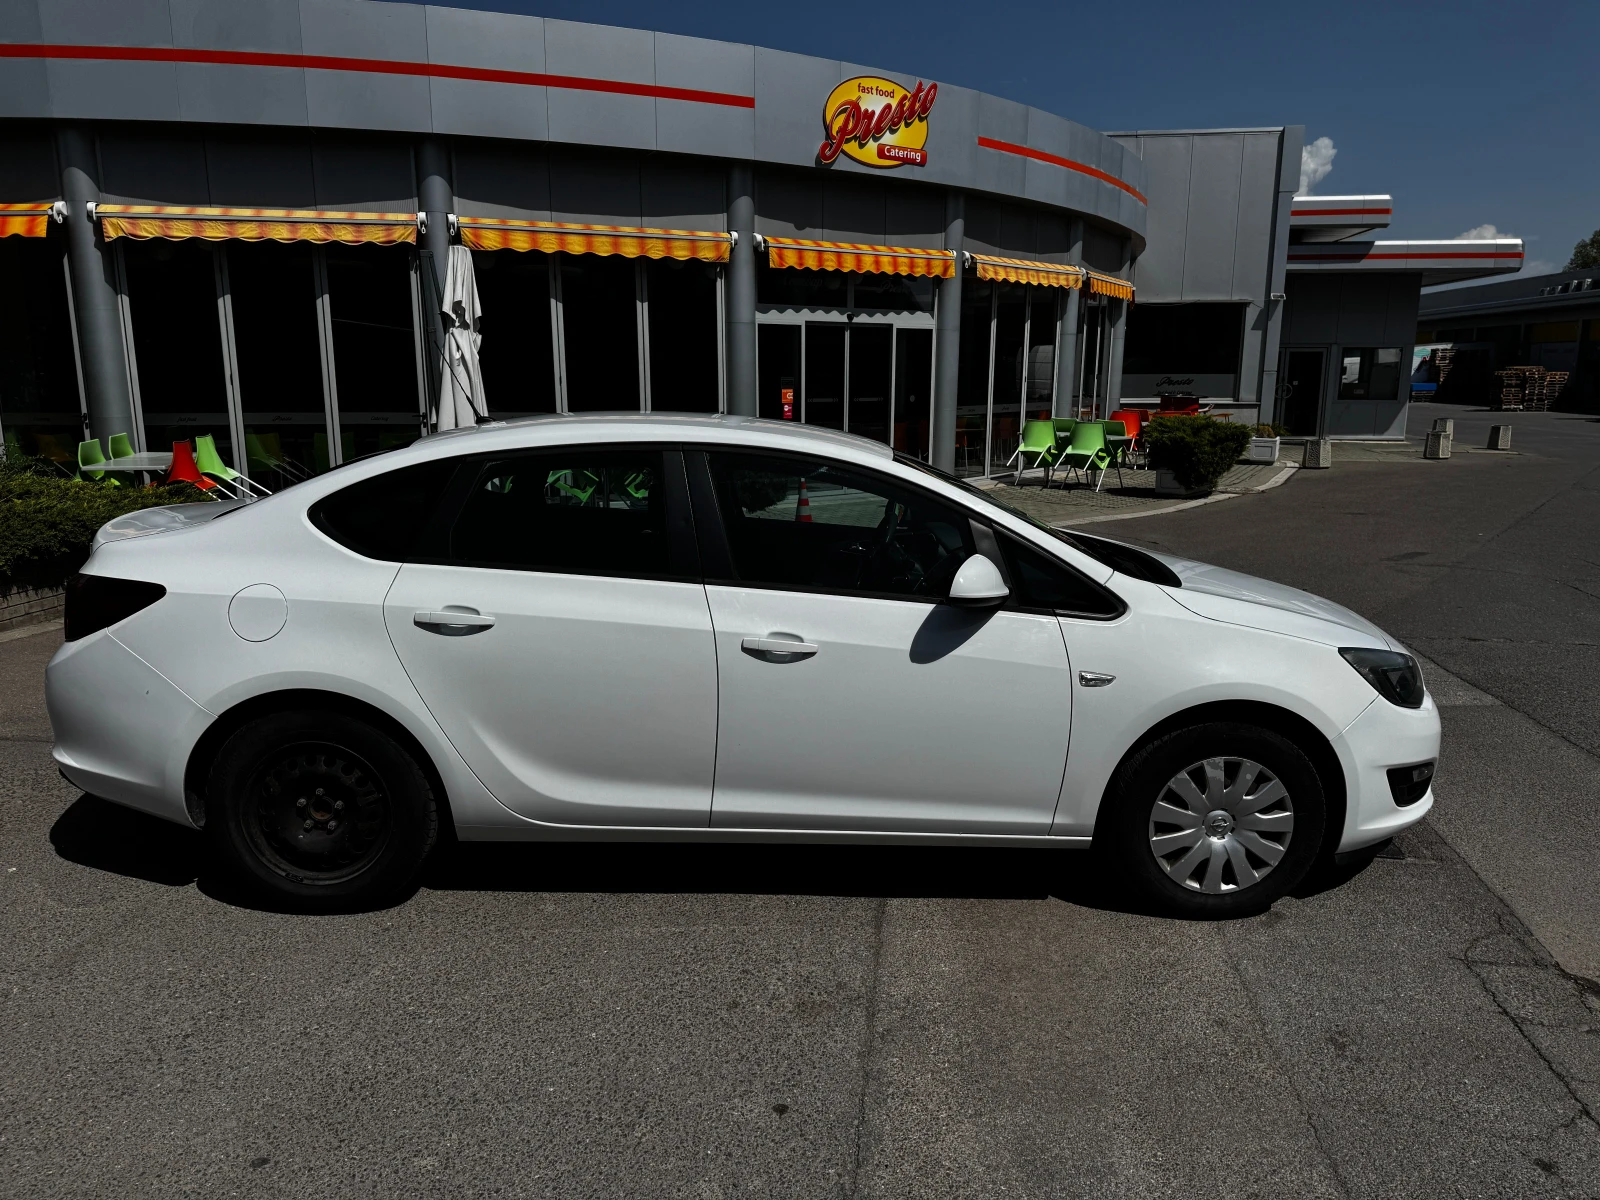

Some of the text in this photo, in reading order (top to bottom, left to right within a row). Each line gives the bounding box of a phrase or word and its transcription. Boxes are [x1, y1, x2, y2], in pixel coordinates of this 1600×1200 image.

[857, 82, 895, 99] fast food
[819, 79, 939, 164] Presto
[884, 145, 921, 162] Catering
